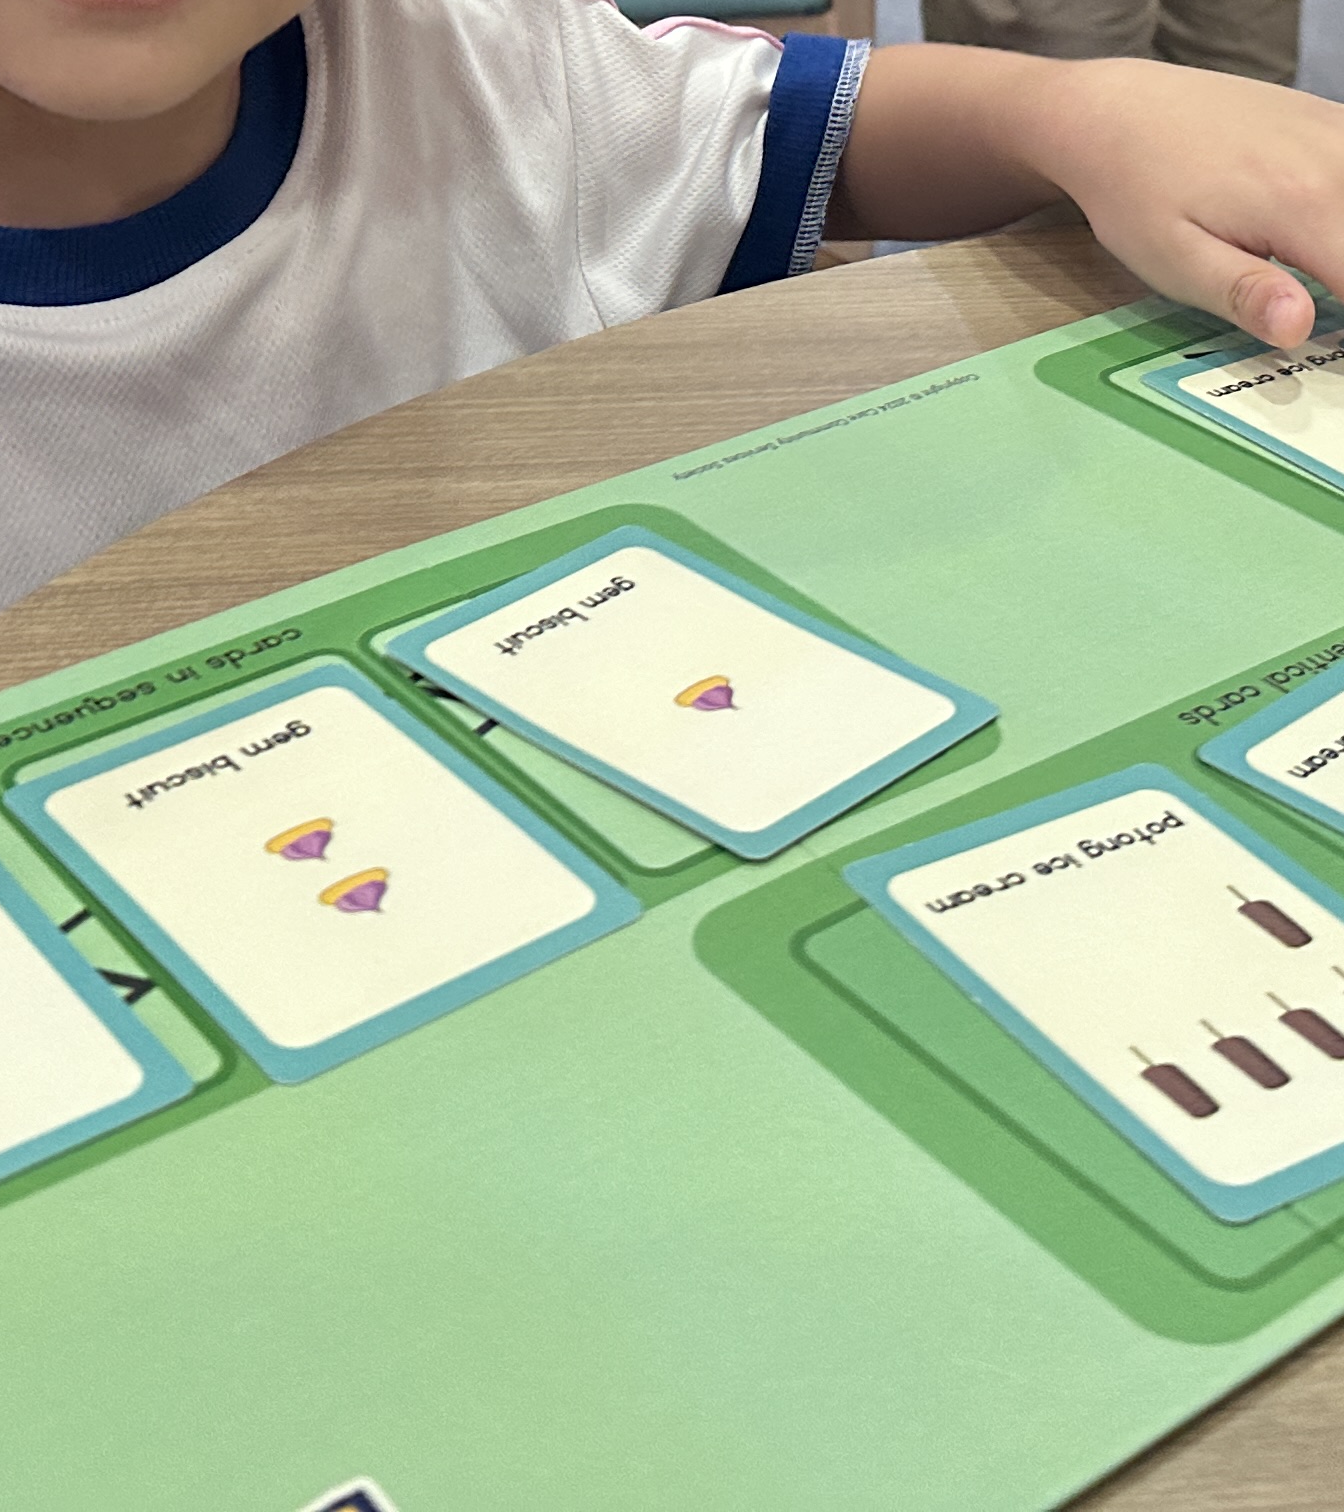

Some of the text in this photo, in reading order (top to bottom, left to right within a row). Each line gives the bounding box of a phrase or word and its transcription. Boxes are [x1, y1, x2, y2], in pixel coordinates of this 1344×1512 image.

[1206, 374, 1275, 398] cream
[1276, 362, 1314, 377] ice
[493, 575, 636, 656] gem biscuit
[205, 627, 303, 670] cards
[165, 664, 202, 683] in
[1177, 684, 1261, 727] cards
[124, 719, 312, 809] gem biscuit
[924, 810, 1185, 913] potong ice cream
